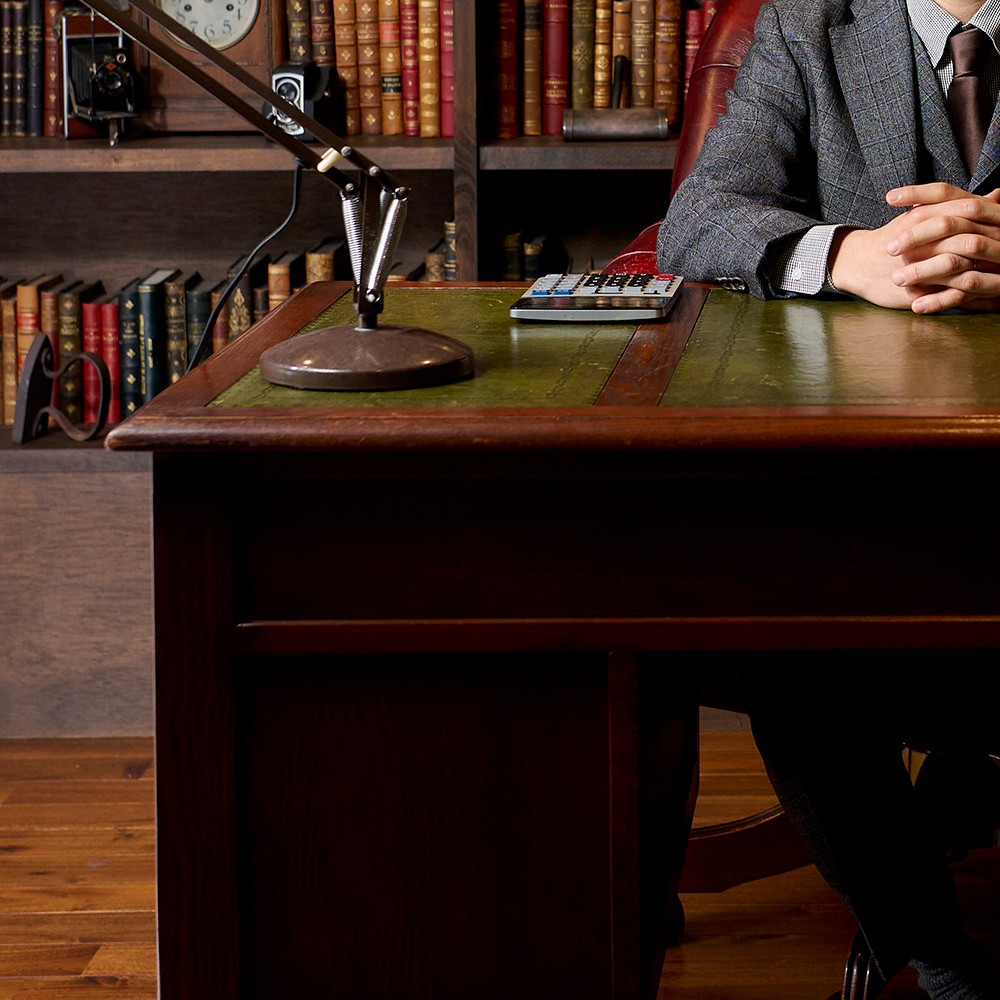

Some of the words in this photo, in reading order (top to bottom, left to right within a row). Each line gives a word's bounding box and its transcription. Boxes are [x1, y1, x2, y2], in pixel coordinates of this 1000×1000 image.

[176, 10, 186, 23] 8
[204, 24, 215, 39] 6
[222, 20, 232, 35] 5
